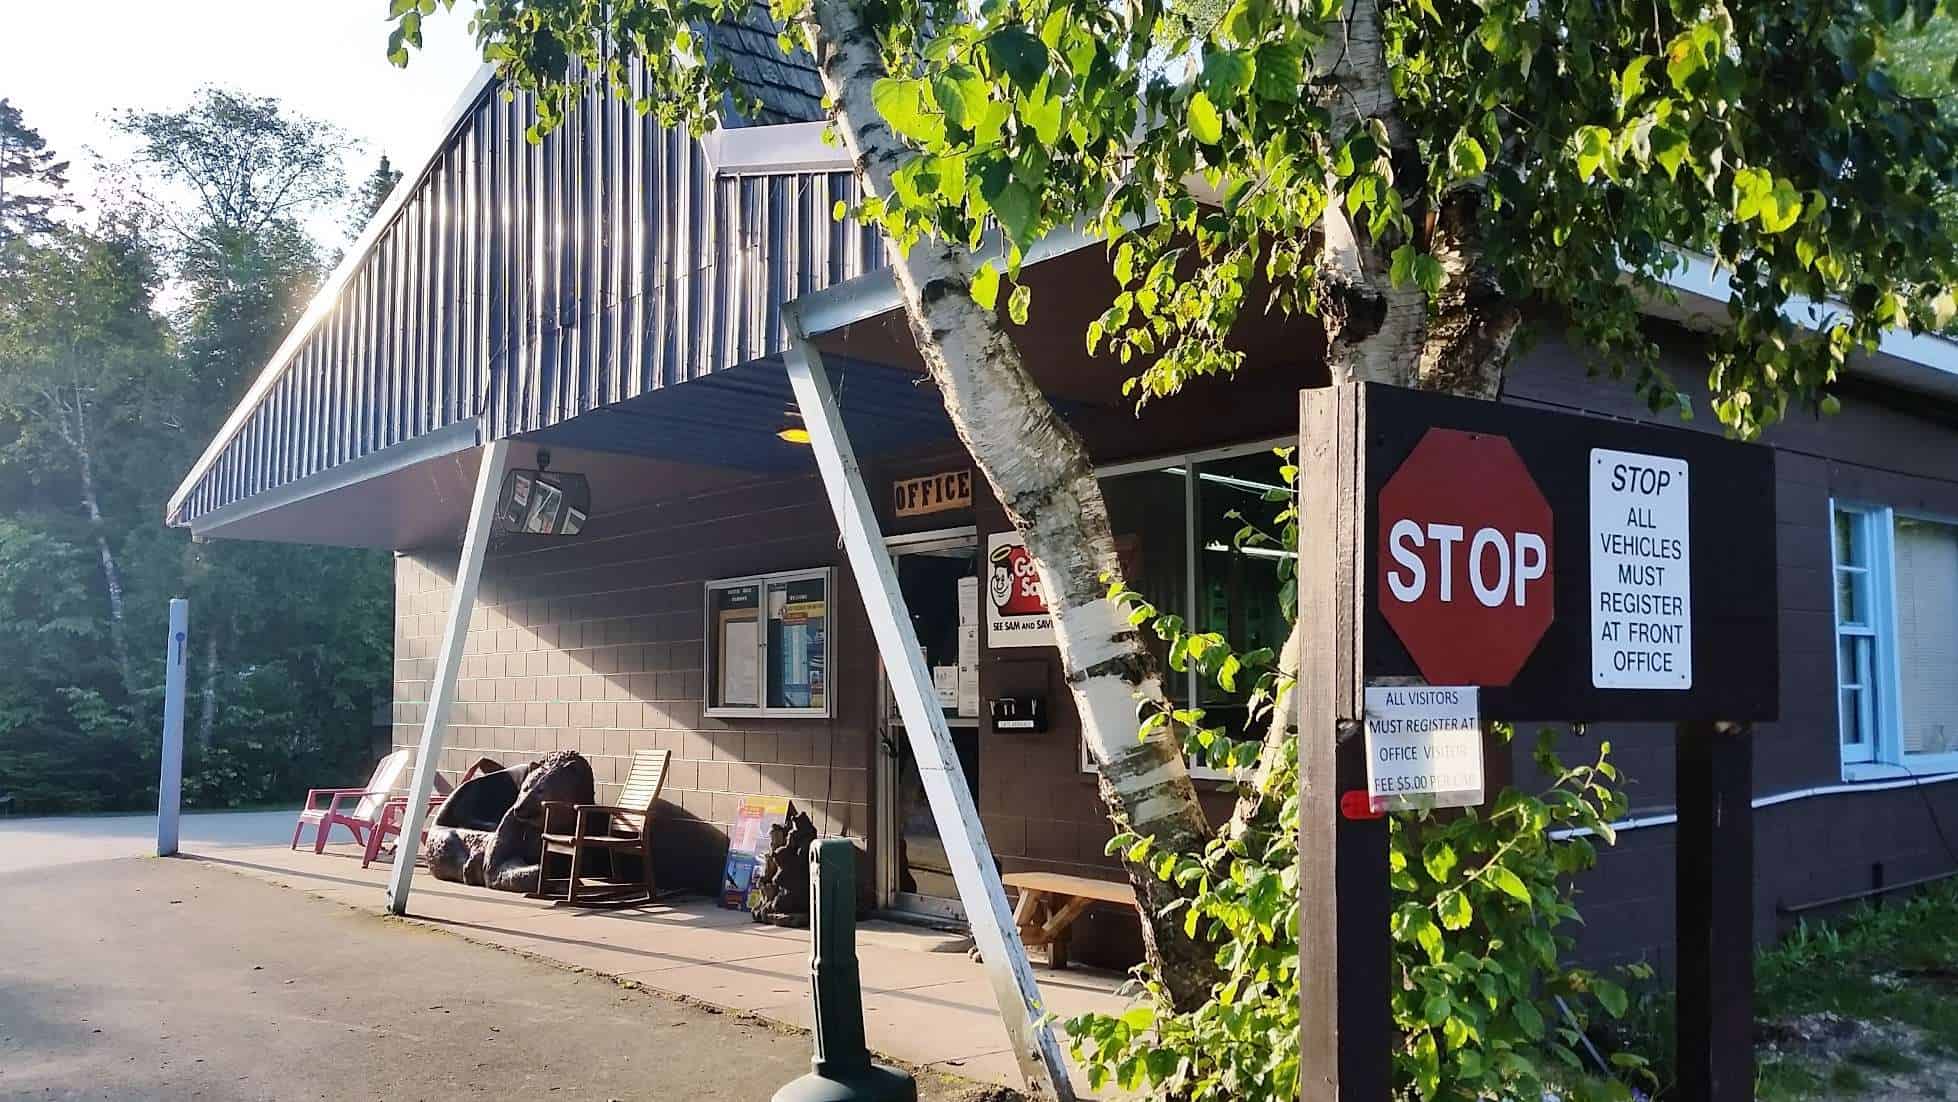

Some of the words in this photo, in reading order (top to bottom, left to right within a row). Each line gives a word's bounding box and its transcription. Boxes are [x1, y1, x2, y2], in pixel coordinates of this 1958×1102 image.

[895, 472, 969, 510] OFFICE
[1611, 464, 1670, 496] STOP
[1626, 506, 1657, 529] ALL
[1600, 532, 1682, 560] VEHICLES
[1014, 556, 1036, 577] Go
[1387, 519, 1547, 607] STOP
[1618, 563, 1665, 587] MUST
[1021, 577, 1042, 597] Sa
[1600, 591, 1682, 616] REGISTER
[993, 622, 1004, 631] SEE
[1005, 621, 1020, 631] SAM
[1021, 622, 1035, 630] AND
[1601, 621, 1621, 641] AT
[1628, 622, 1683, 644] FRONT
[1613, 650, 1673, 672] OFFICE
[1386, 691, 1406, 706] ALL
[1408, 690, 1459, 705] VISITORS
[1369, 719, 1404, 734] MUST
[1406, 717, 1458, 733] REGISTER
[1460, 717, 1476, 730] AT
[1379, 746, 1417, 762] OFFICE
[1375, 777, 1394, 792] FEE
[1396, 776, 1428, 791] $5.00
